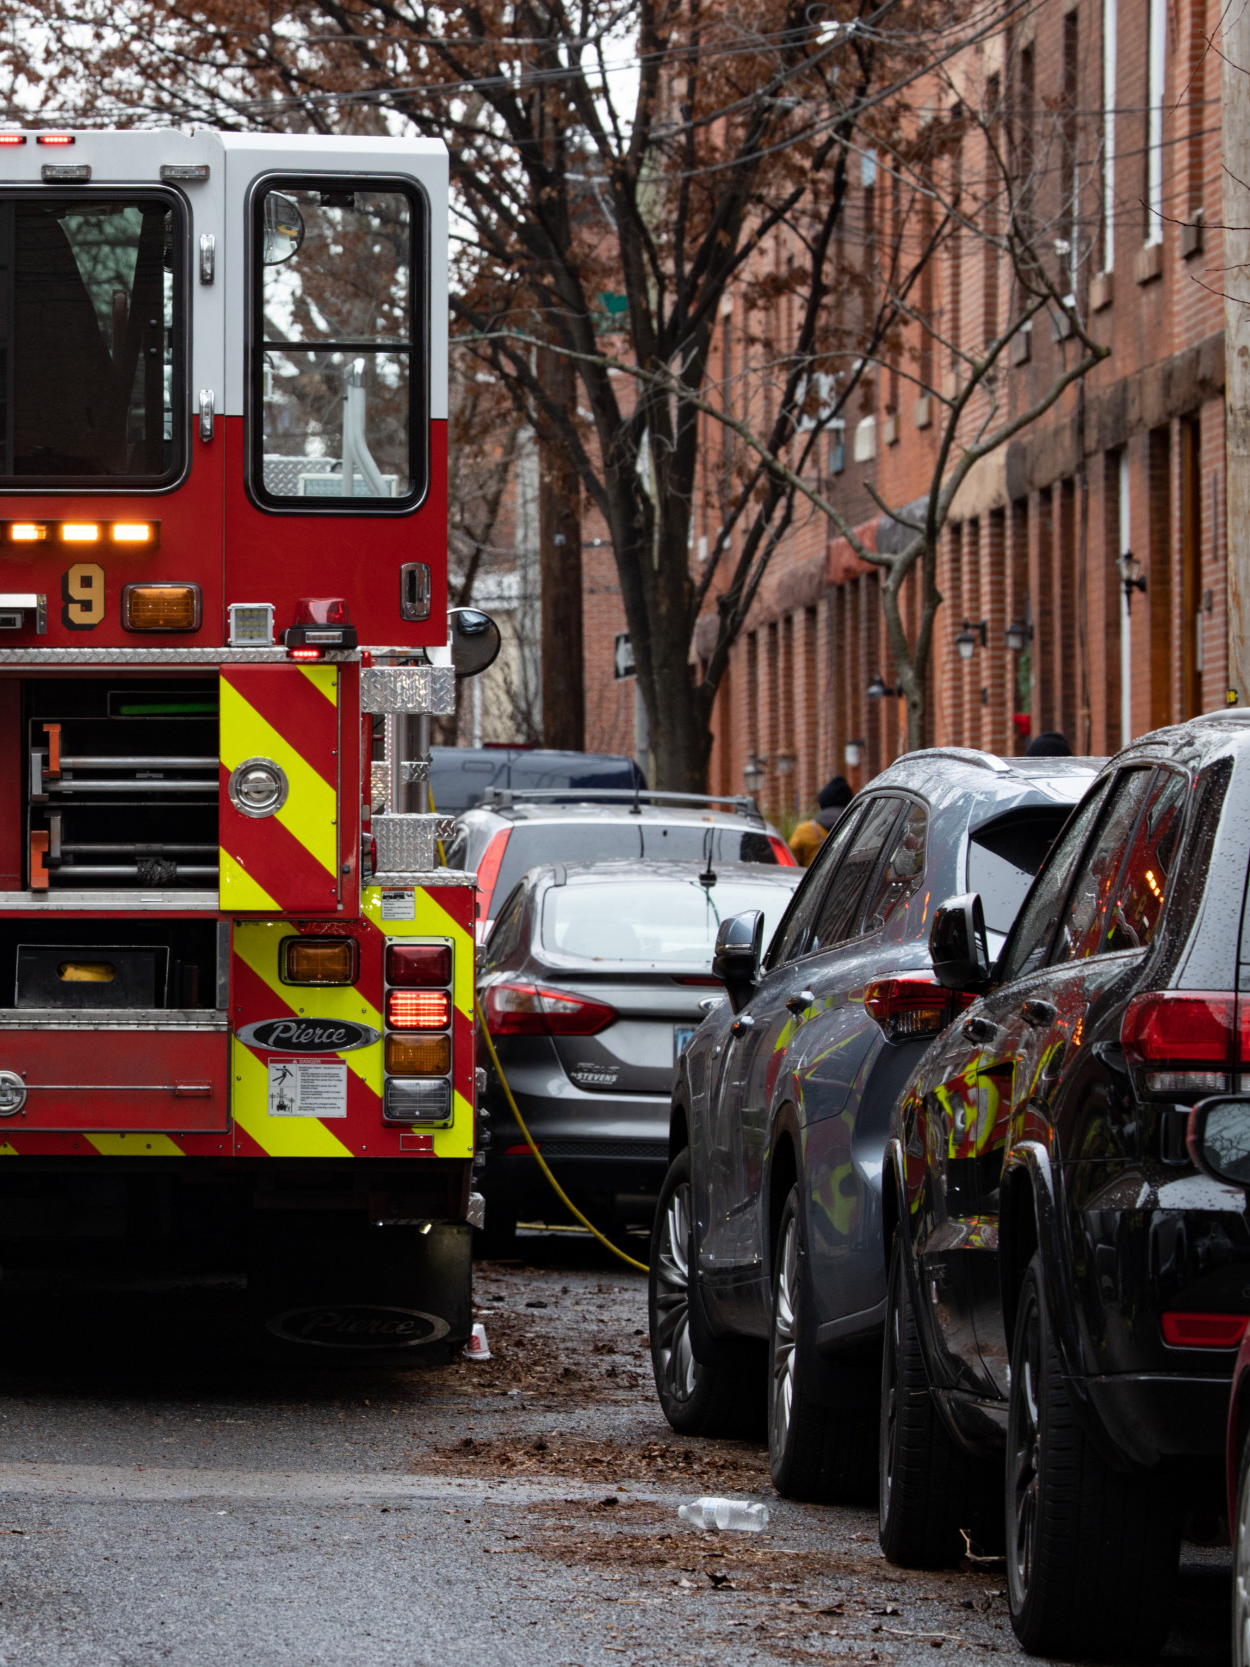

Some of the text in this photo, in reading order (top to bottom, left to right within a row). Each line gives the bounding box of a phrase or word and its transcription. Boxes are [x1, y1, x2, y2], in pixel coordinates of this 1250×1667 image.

[61, 562, 105, 630] 9
[267, 1021, 347, 1047] Pierce
[576, 1072, 618, 1082] STEVENS
[302, 1311, 416, 1337] Pierce
